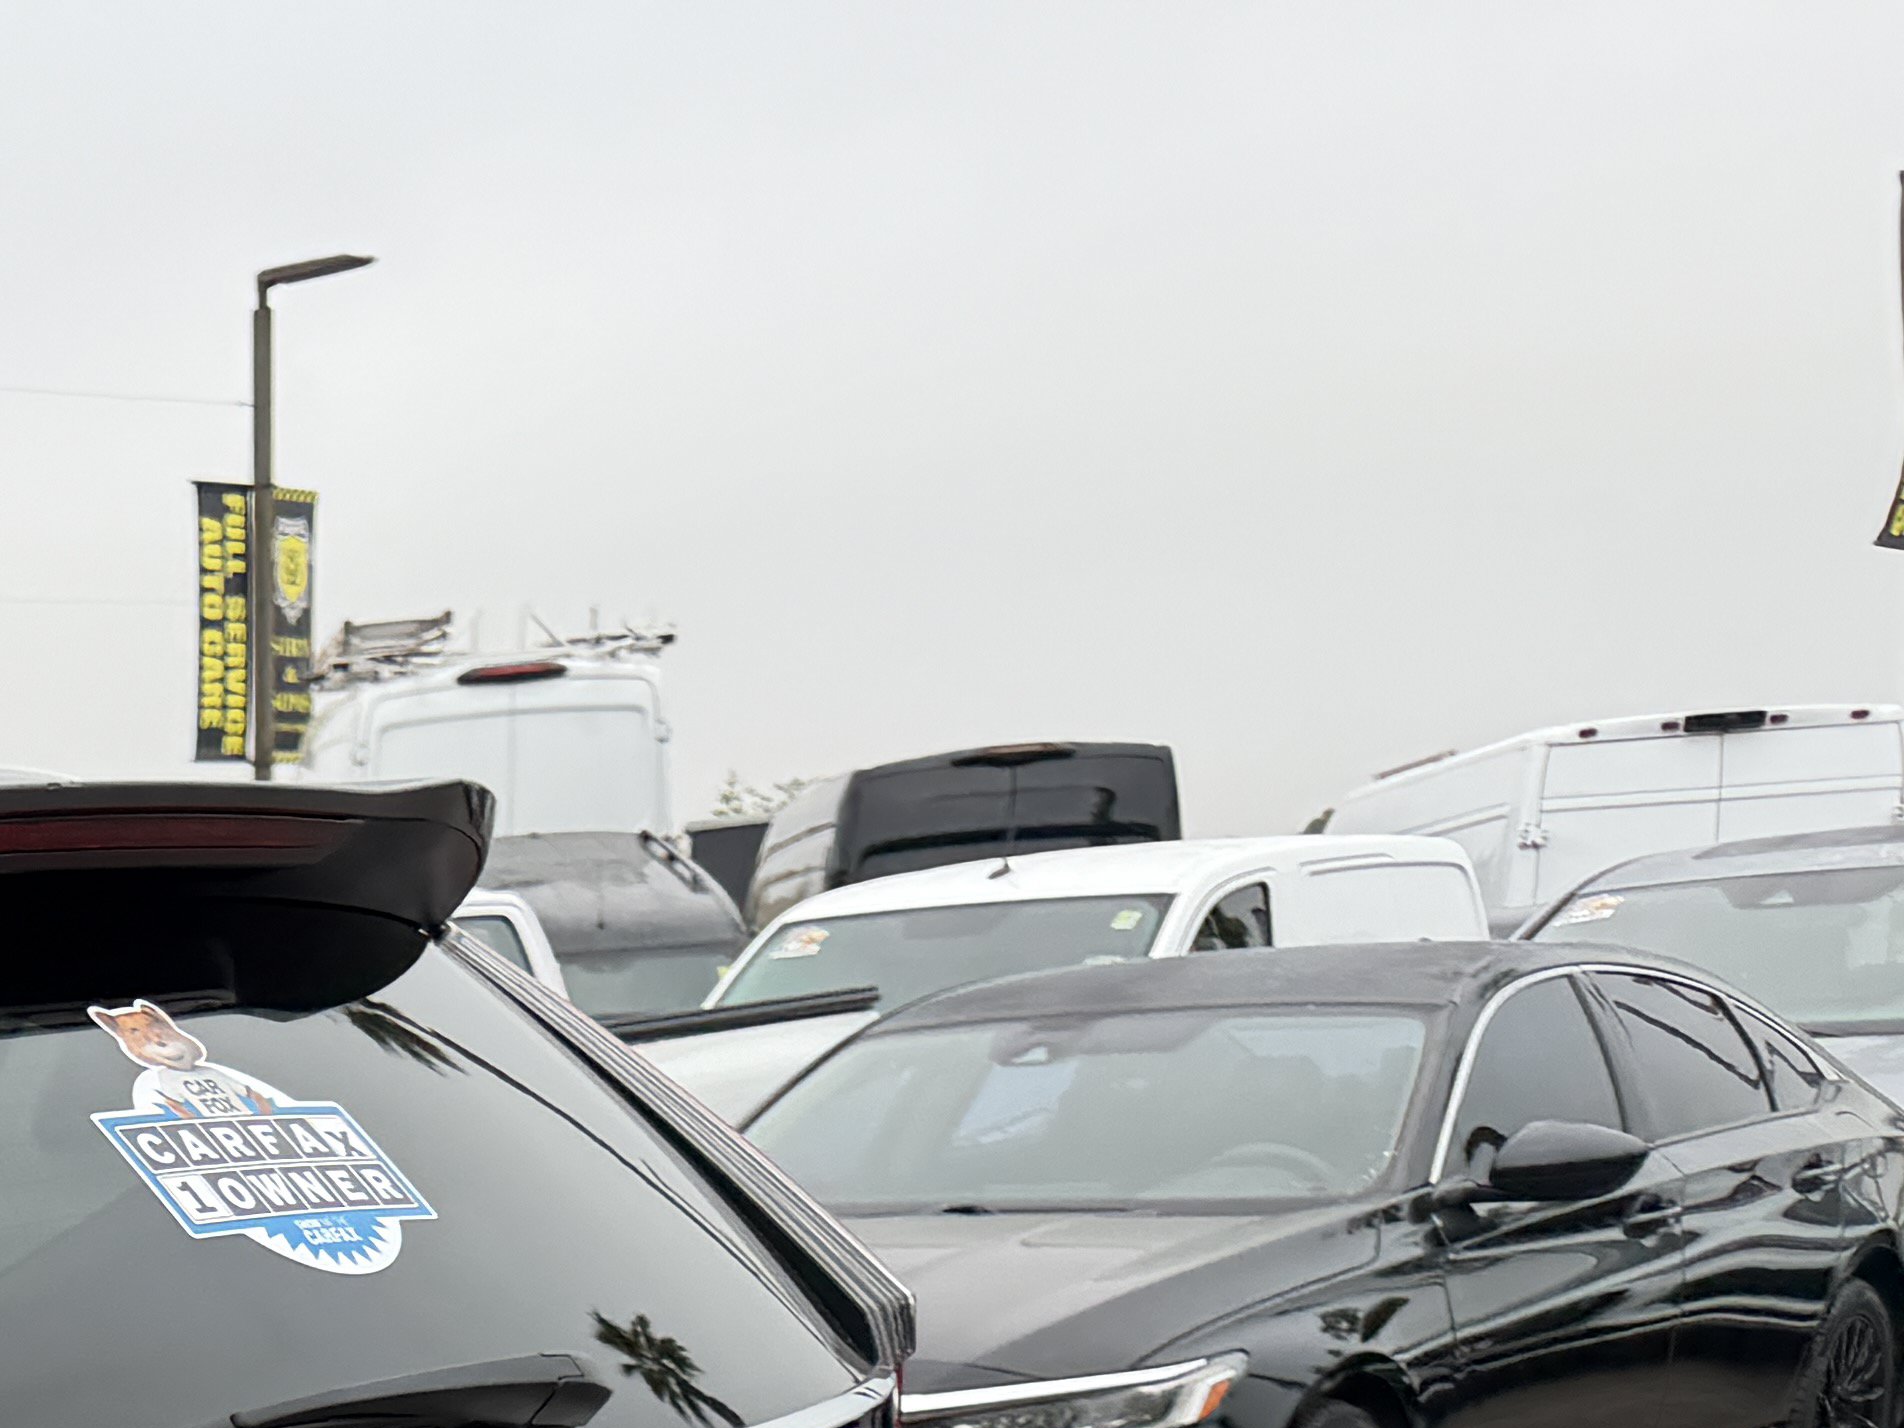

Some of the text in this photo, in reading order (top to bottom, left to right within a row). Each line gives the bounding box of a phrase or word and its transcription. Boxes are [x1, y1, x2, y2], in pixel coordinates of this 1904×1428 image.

[182, 1078, 223, 1097] CAR
[199, 1096, 242, 1114] FOX
[135, 1119, 362, 1165] CARFAX
[172, 1166, 404, 1215] 1 OWNER
